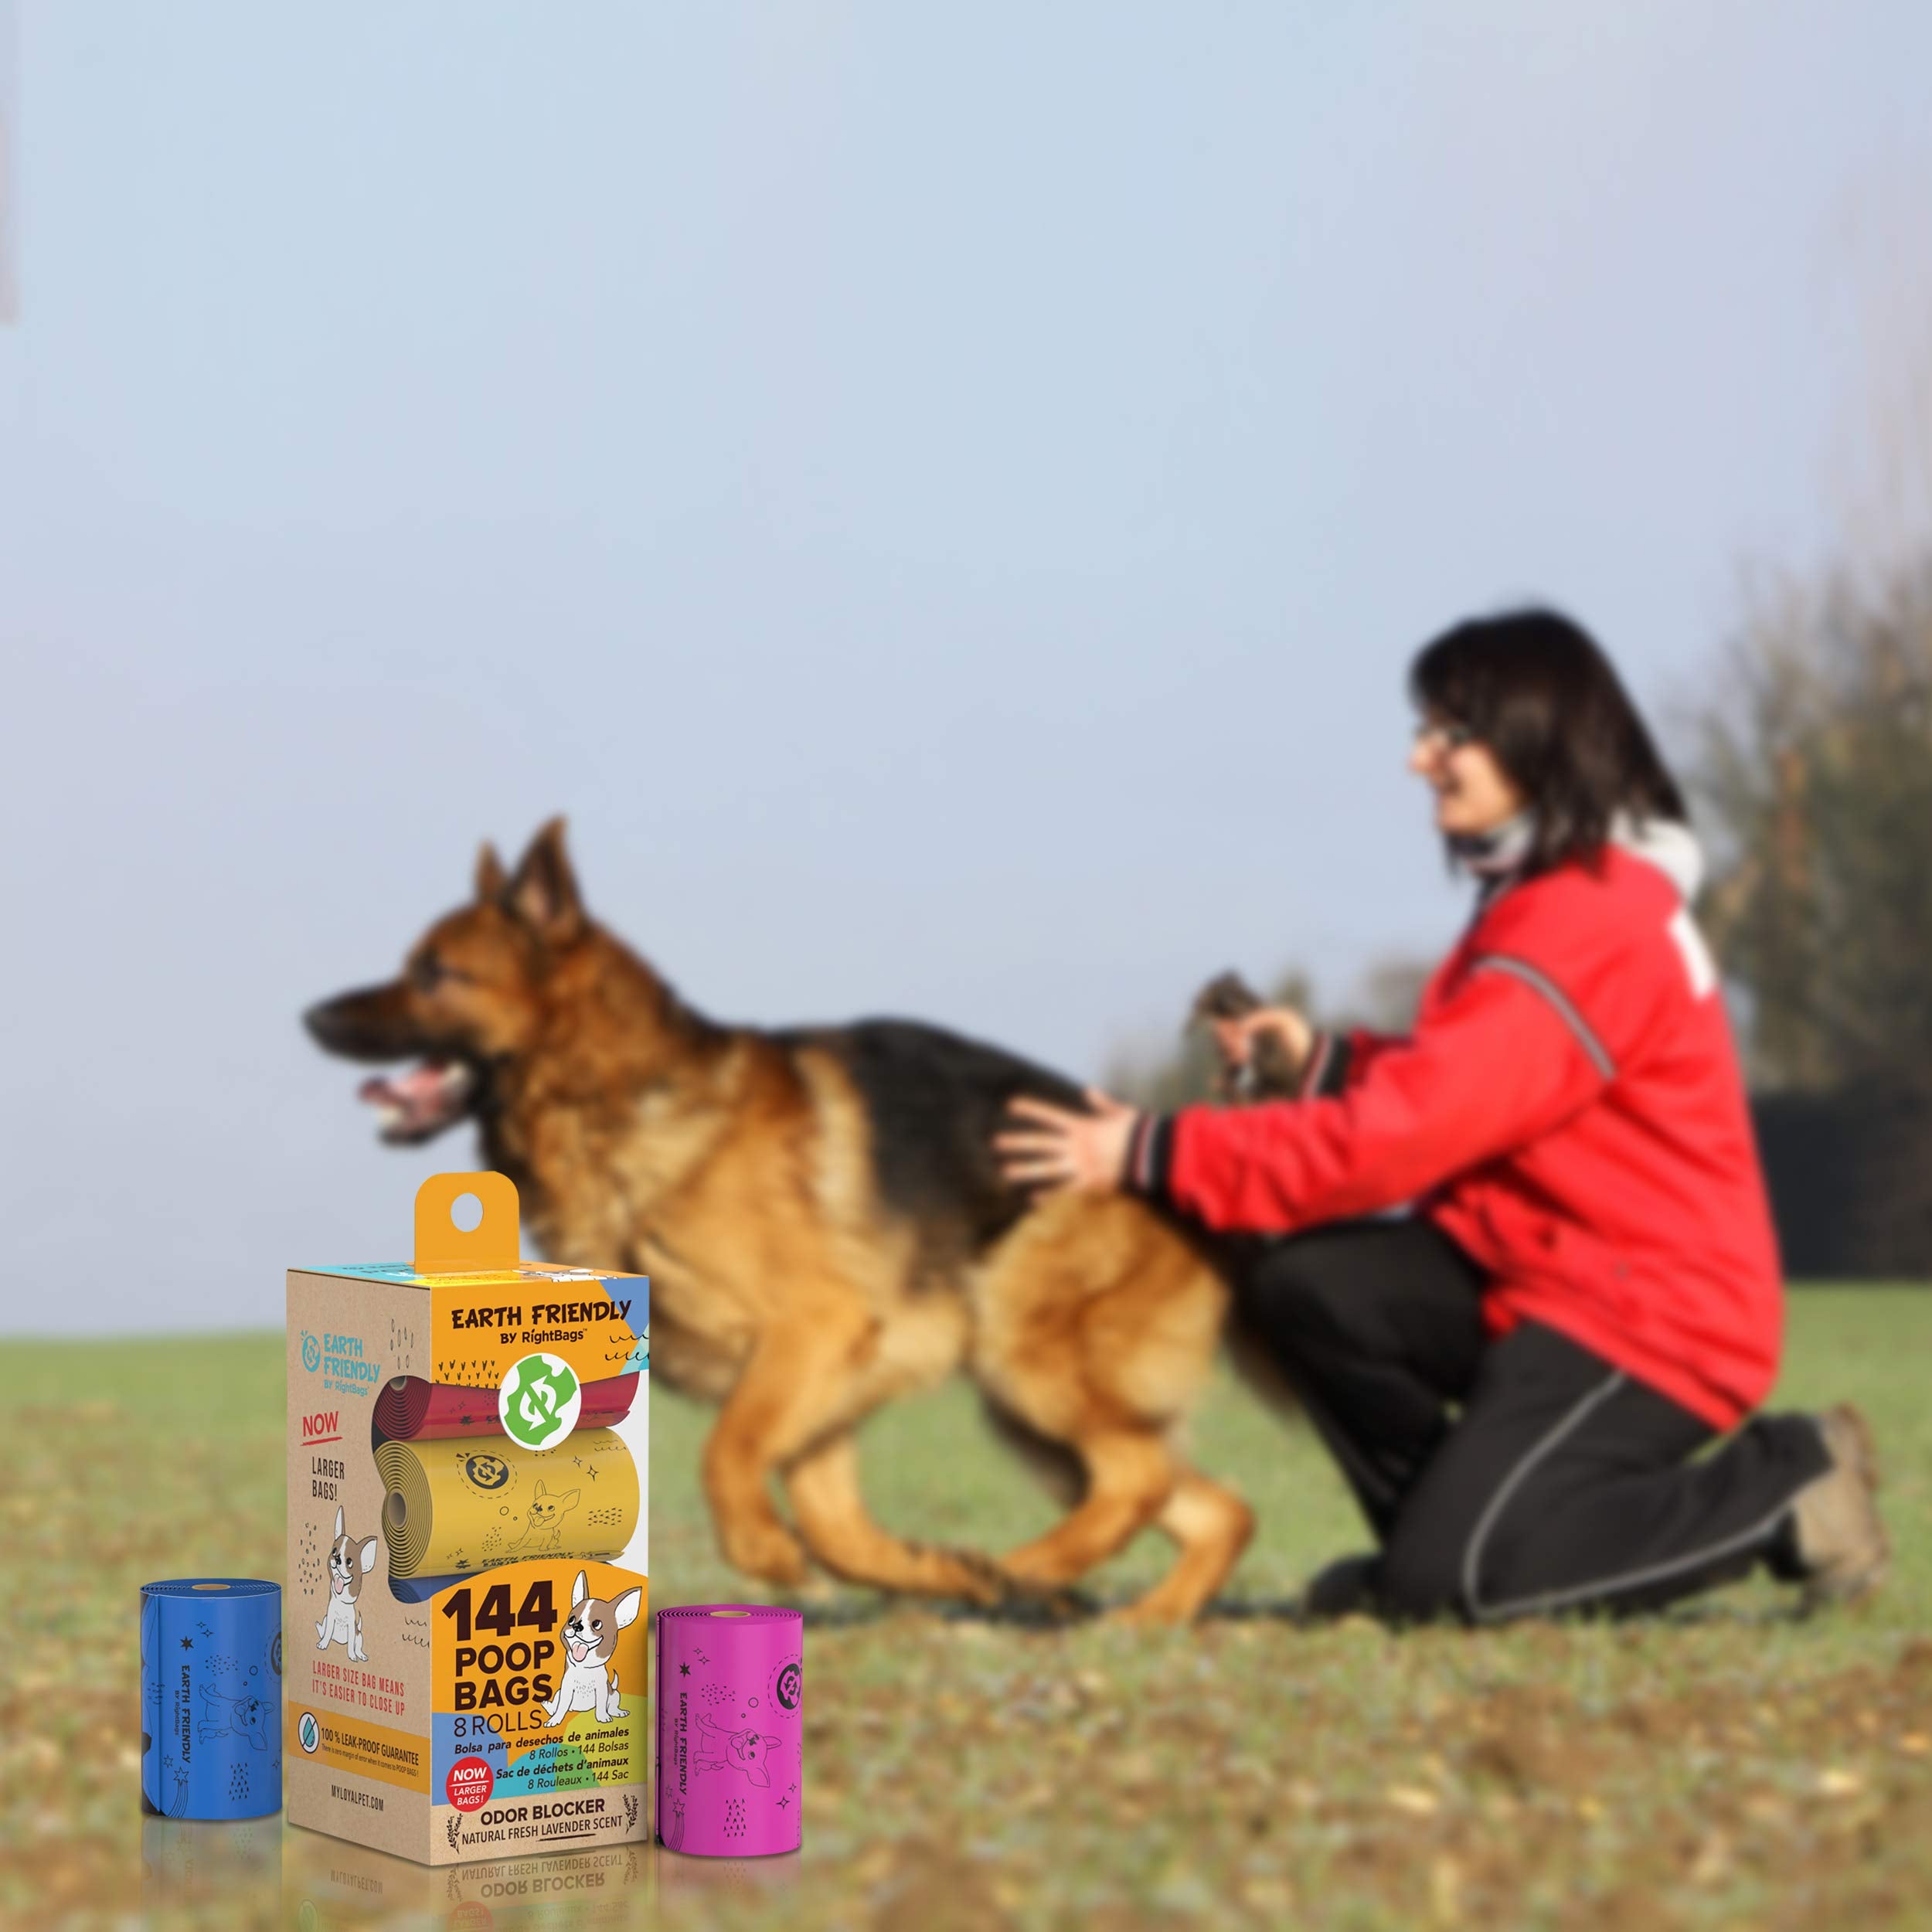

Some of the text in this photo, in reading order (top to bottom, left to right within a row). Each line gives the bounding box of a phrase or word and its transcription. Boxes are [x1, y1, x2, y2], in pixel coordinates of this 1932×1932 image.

[451, 1299, 631, 1329] EARTH FRIENDLY
[324, 1333, 362, 1358] EARTH
[500, 1332, 517, 1344] BY
[324, 1357, 380, 1383] FRIENDLY
[324, 1379, 332, 1389] BY
[303, 1411, 338, 1437] NOW
[312, 1456, 345, 1480] LARGER
[312, 1480, 338, 1501] BAGS!
[442, 1580, 558, 1641] 144
[455, 1640, 555, 1677] POOP
[312, 1660, 404, 1697] LARGER SIZE BAG MEANS
[312, 1679, 405, 1716] IT'S EASIER TO CLOSE UP
[454, 1674, 553, 1711] BAGS
[182, 1665, 191, 1764] EARTH FRIENDLY
[454, 1709, 542, 1737] 8 ROLLS
[321, 1727, 333, 1742] 100
[342, 1733, 379, 1754] LEAK-PROOF
[381, 1744, 419, 1766] GUARANTEE
[455, 1727, 629, 1754] Bolsa para desechos de animales
[529, 1741, 629, 1760] 8 Rollos 144 Bolsas
[453, 1767, 487, 1781] NOW
[496, 1768, 514, 1780] Sac
[516, 1766, 530, 1777] de
[533, 1761, 573, 1775] déchets
[528, 1769, 629, 1789] 8 Rouleaux 144 Sac
[331, 1784, 384, 1811] MYLOYALPET.COM
[454, 1785, 487, 1796] LARGER
[457, 1795, 484, 1806] BAGS!
[481, 1798, 605, 1825] ODOR BLOCKER
[462, 1815, 623, 1845] NATURAL FRESH LAVENDER SCENT
